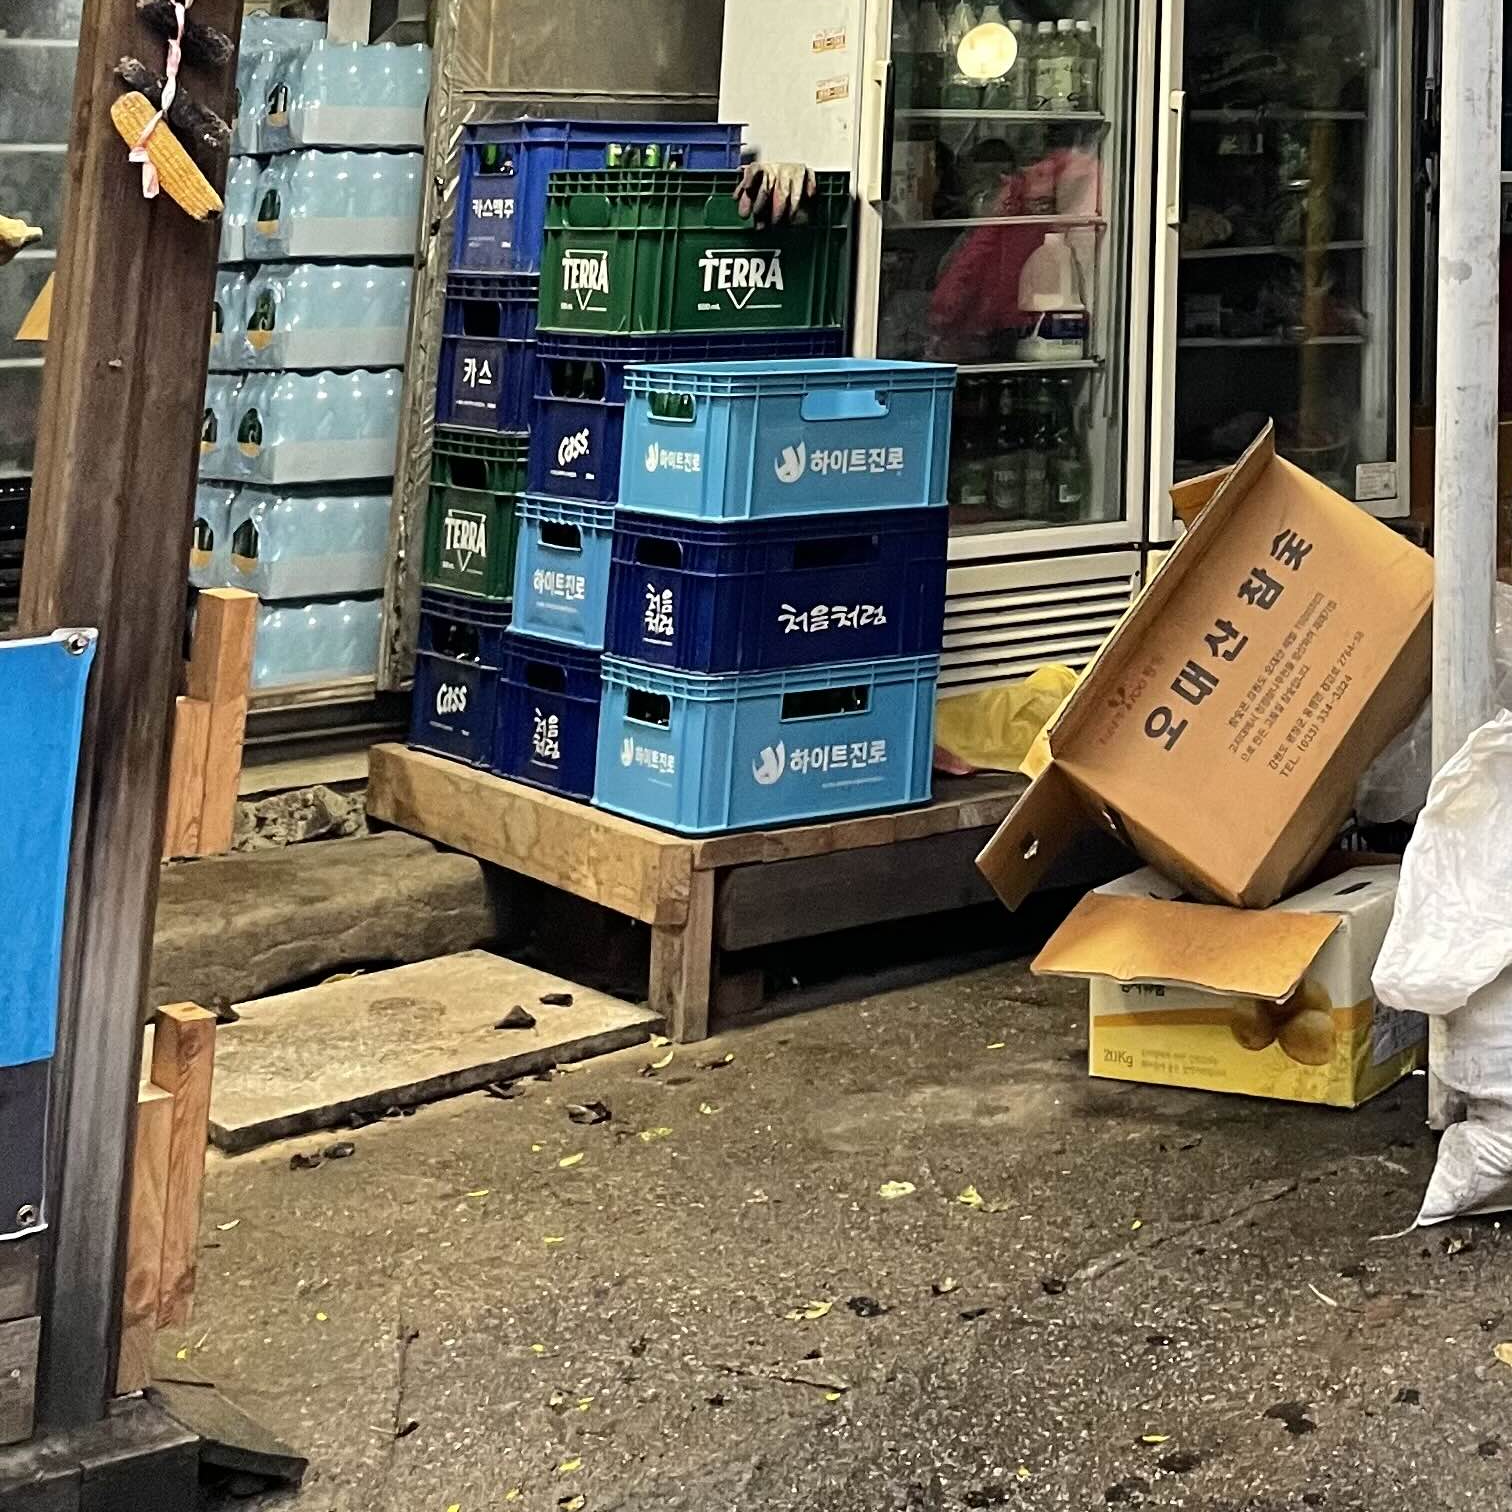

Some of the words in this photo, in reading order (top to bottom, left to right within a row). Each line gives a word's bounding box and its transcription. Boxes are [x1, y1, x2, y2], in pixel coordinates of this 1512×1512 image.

[472, 198, 515, 219] 카스맥주
[562, 257, 609, 294] TERRA
[698, 257, 784, 292] TERRA
[463, 357, 492, 388] 카스
[810, 447, 904, 475] 하이트진로
[444, 517, 487, 558] TERRA
[533, 569, 586, 600] 하이트진로
[777, 602, 888, 634] 처음처럼
[1144, 619, 1249, 751] 오대산
[1237, 528, 1313, 610] 참숯
[633, 744, 676, 775] 하이트진로
[789, 739, 889, 772] 하이트진로
